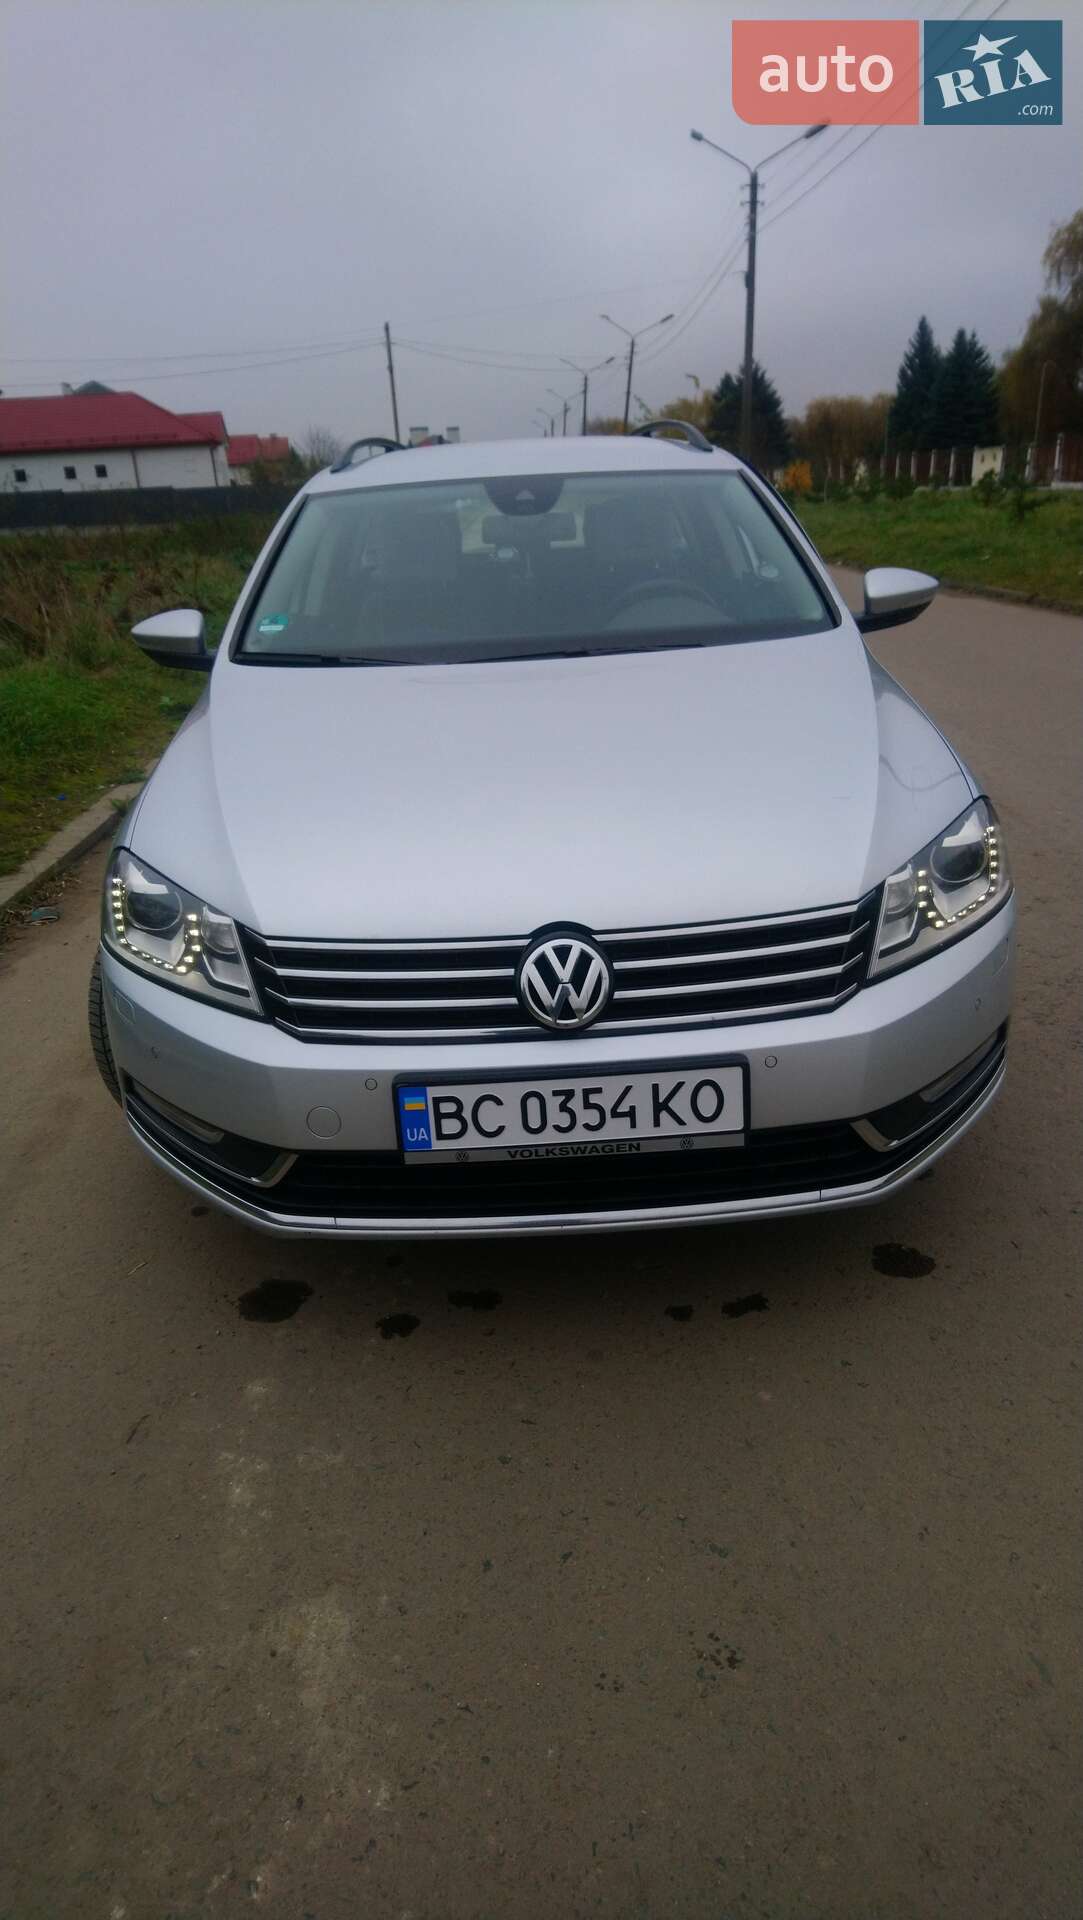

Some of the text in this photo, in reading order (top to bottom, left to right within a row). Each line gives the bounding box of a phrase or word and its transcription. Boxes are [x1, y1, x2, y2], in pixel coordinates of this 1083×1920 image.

[431, 1078, 725, 1141] BC 0354 KO
[406, 1127, 430, 1142] UA
[507, 1142, 641, 1160] VOLKSWAGEN
